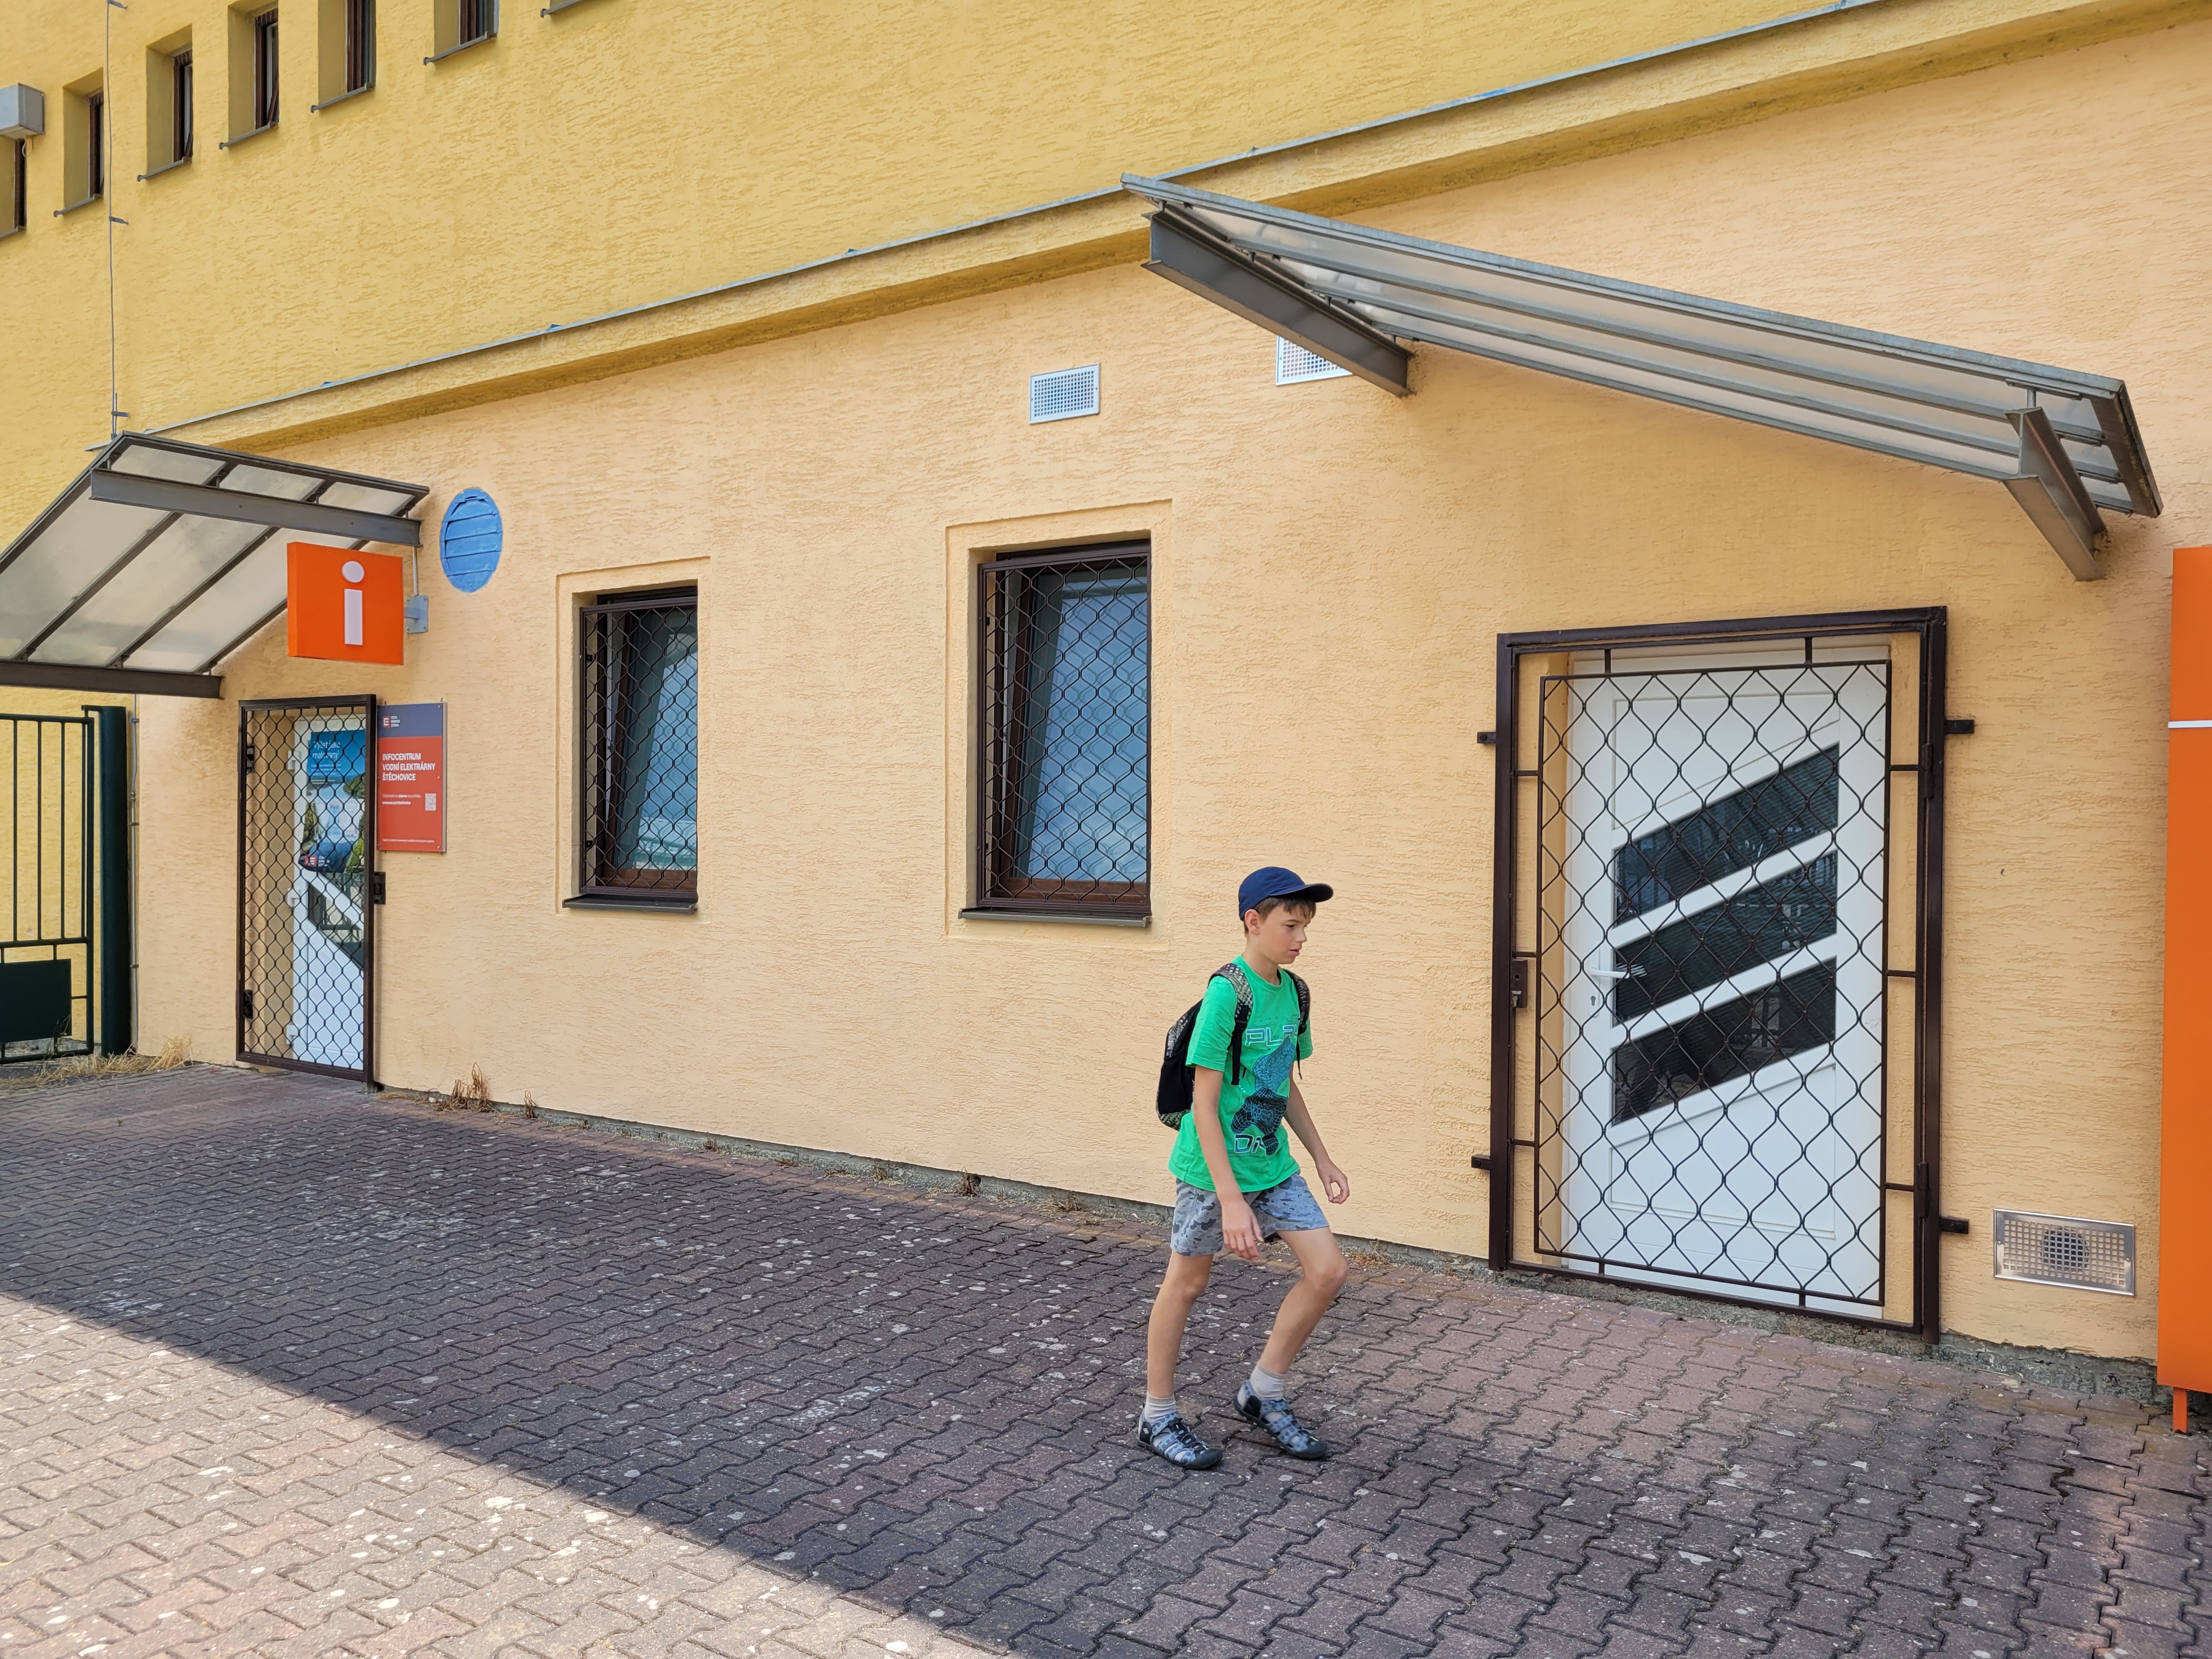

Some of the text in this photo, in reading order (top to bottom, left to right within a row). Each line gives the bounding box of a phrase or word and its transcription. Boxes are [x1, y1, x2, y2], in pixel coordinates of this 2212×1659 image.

[382, 753, 421, 761] INFOCENTRUM
[382, 761, 436, 771] VODNÍ ELEKTRÁRNY
[382, 772, 416, 781] ŠTĚCHOVICE
